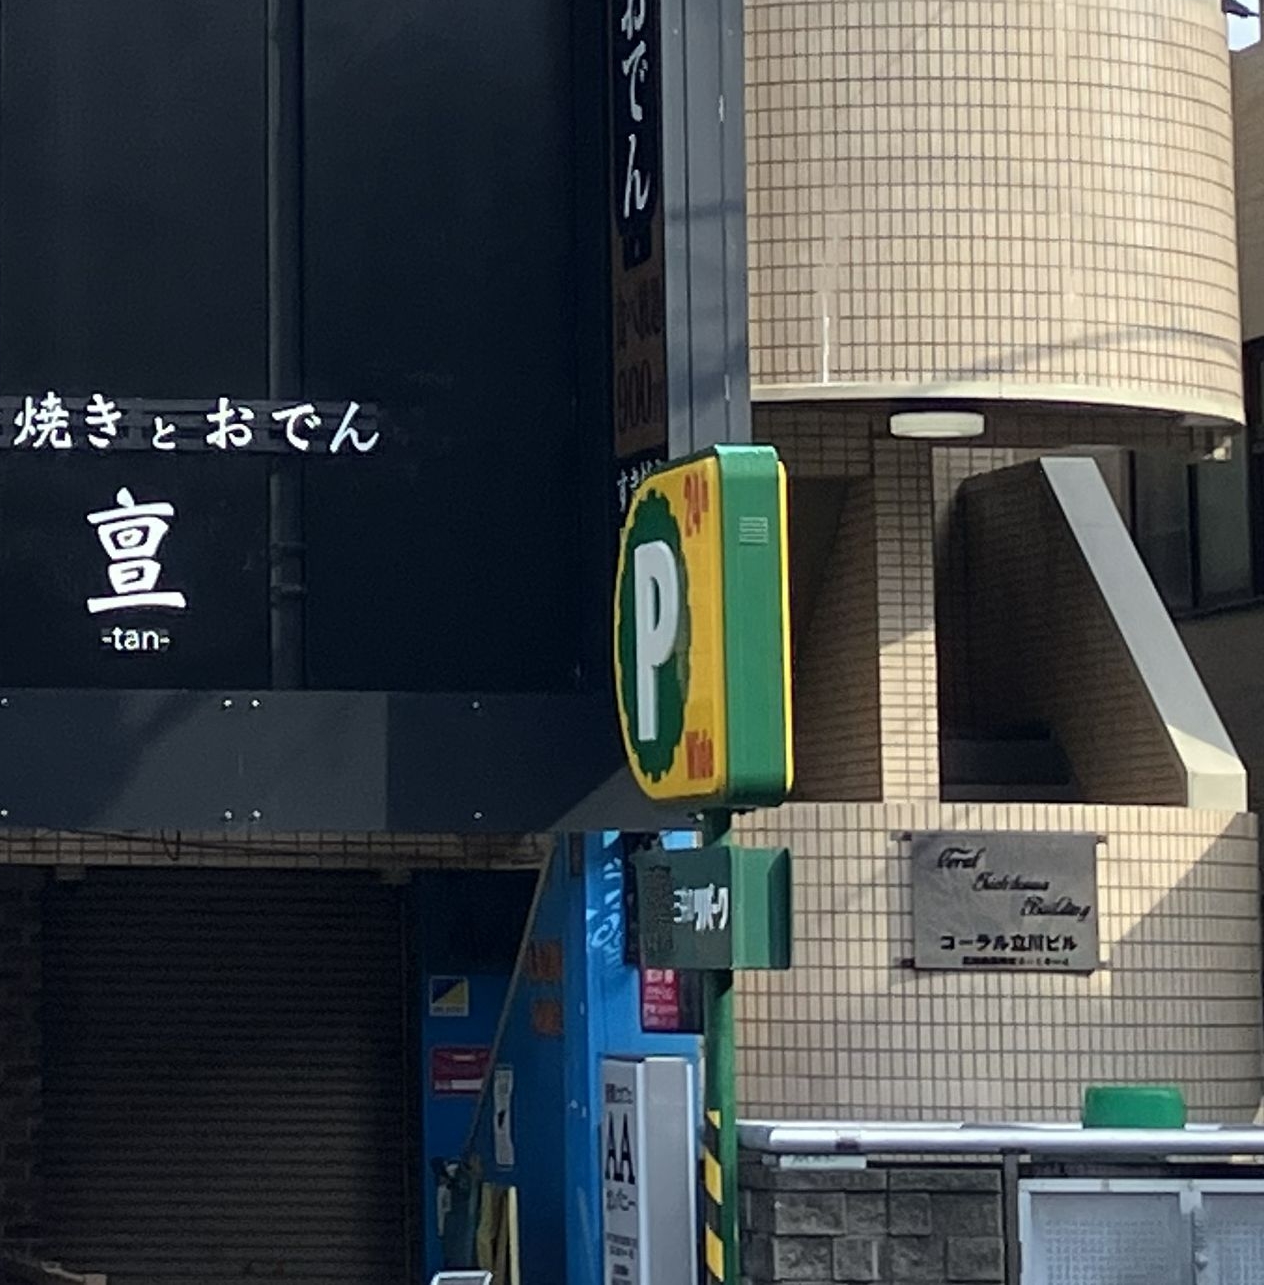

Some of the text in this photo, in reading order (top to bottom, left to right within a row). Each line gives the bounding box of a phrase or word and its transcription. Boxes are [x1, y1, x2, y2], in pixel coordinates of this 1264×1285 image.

[633, 539, 680, 742] P
[939, 933, 1079, 953] コーラル立川ビル
